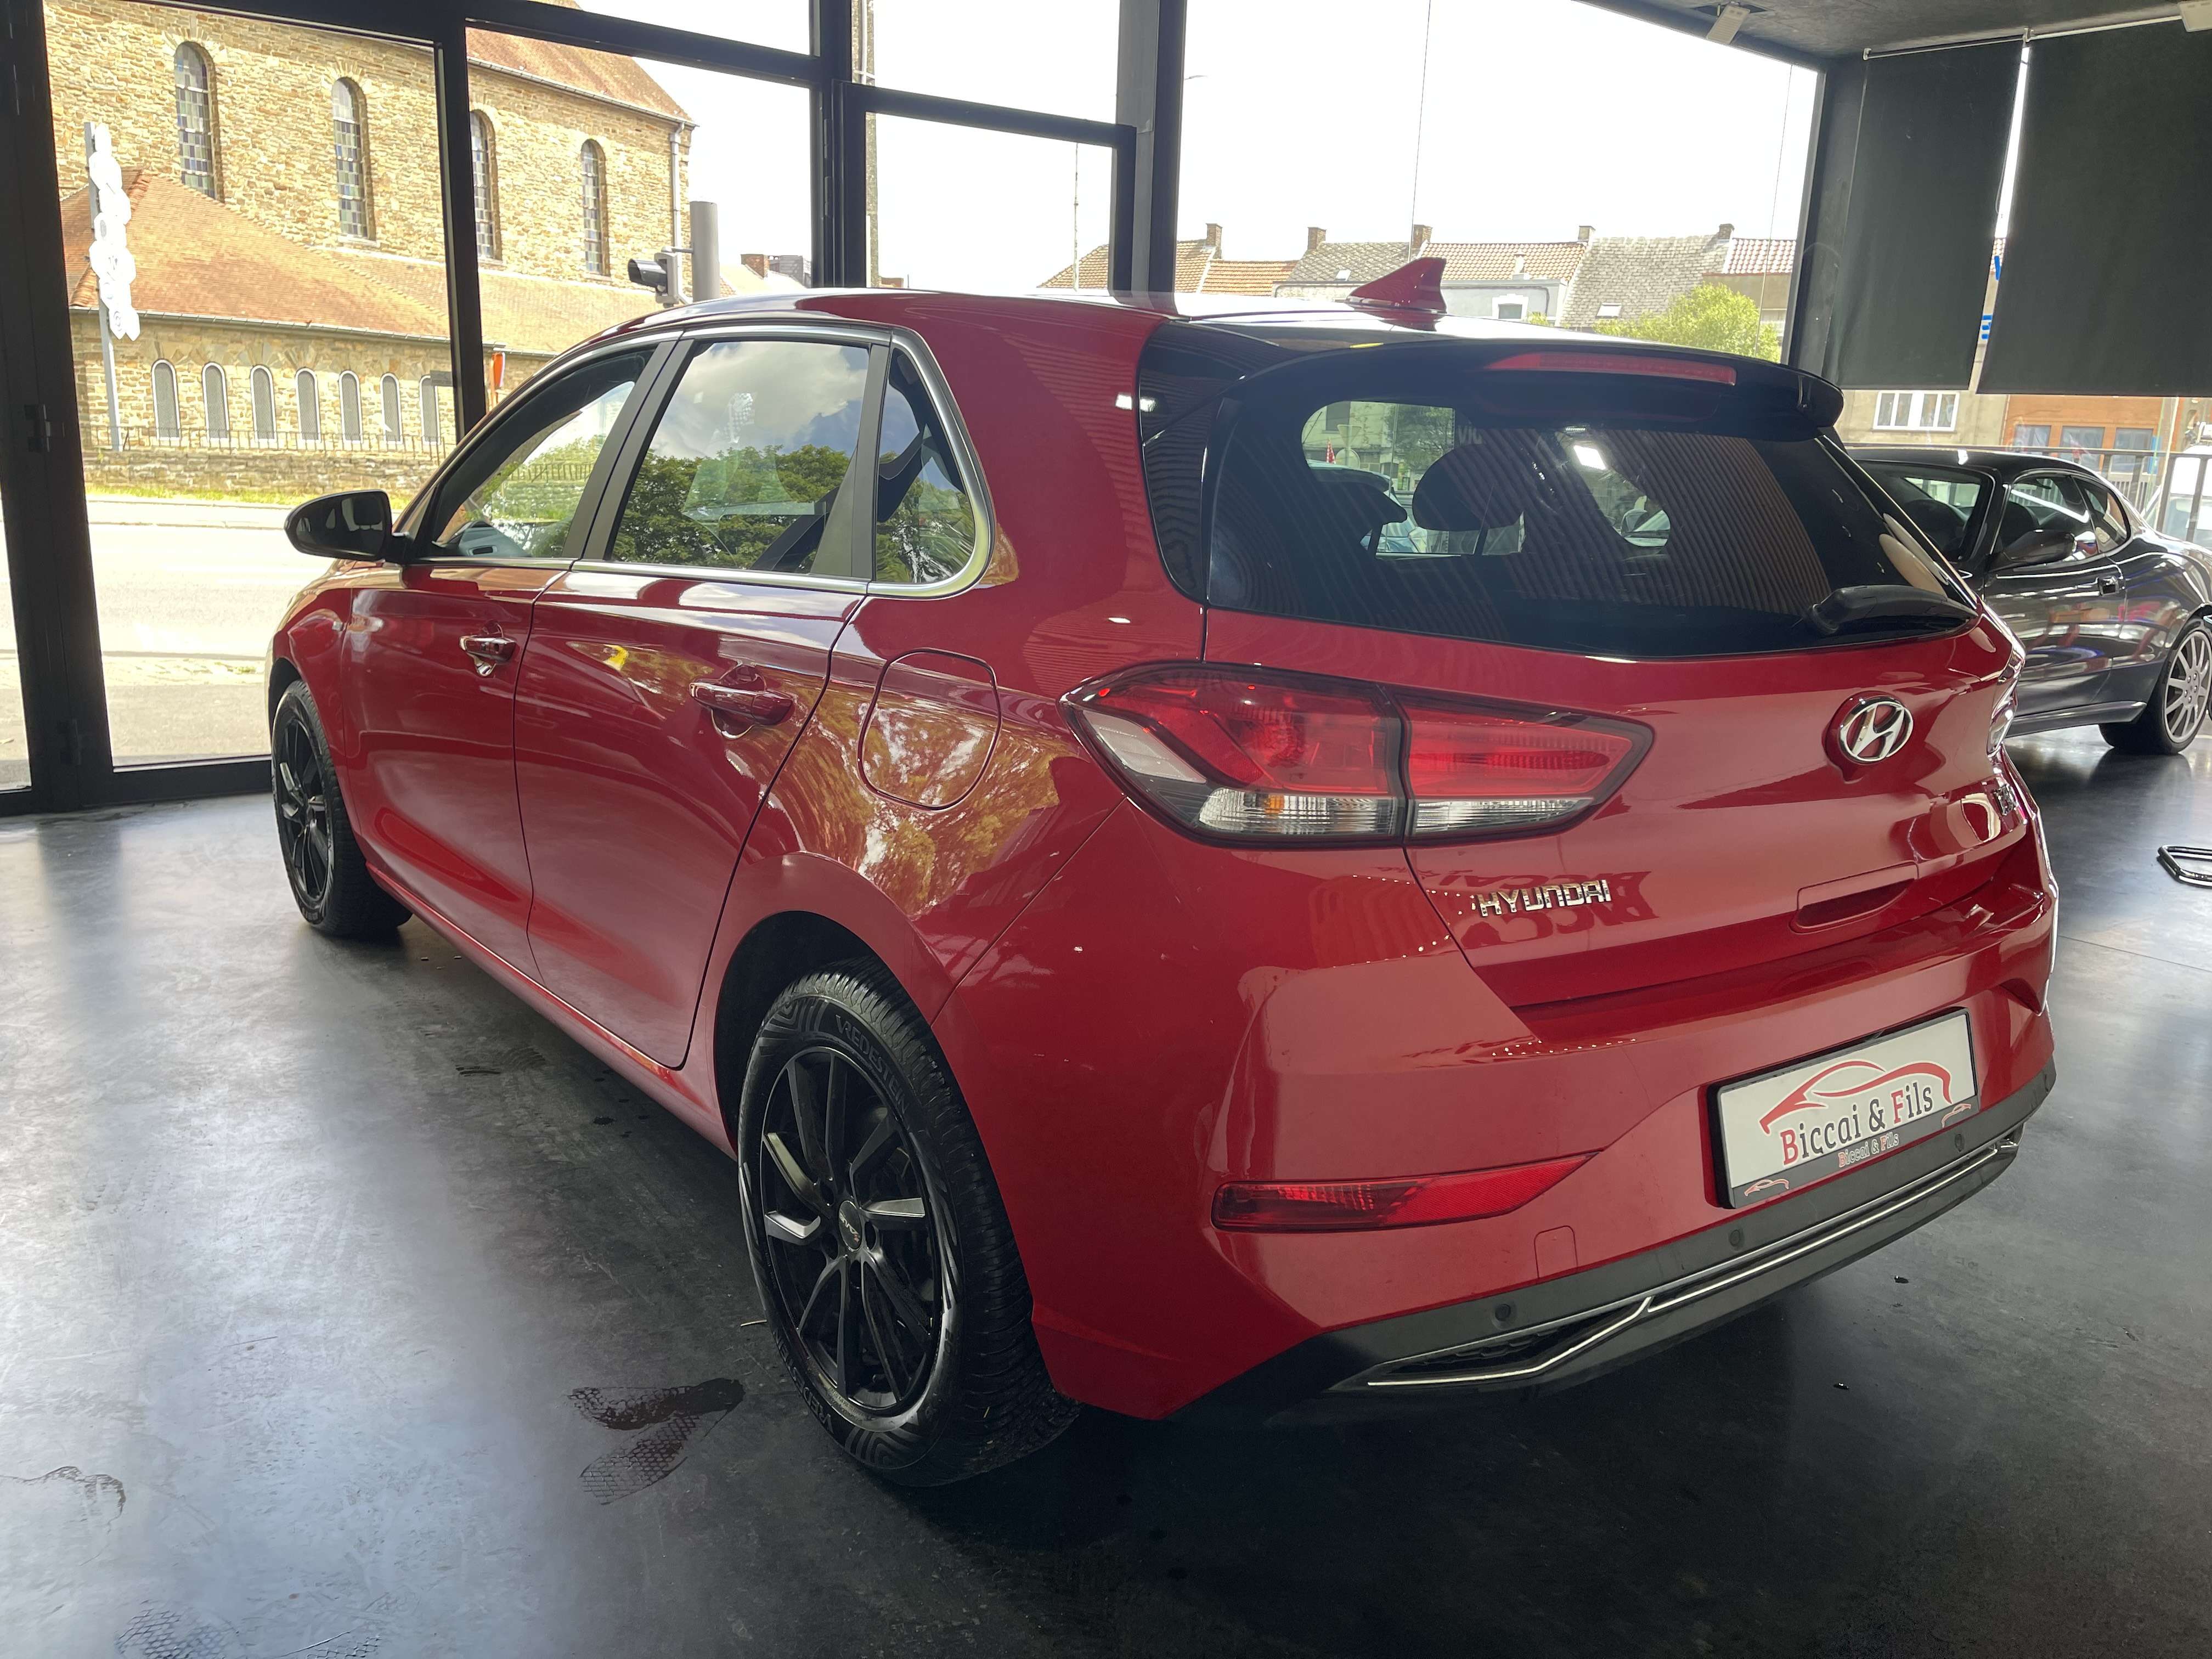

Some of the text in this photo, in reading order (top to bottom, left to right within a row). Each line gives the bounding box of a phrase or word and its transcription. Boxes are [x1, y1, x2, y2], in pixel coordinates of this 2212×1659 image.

[1476, 879, 1611, 917] HYUNDAI
[1780, 1082, 1933, 1165] Biccai & Fils
[1838, 1132, 1899, 1168] Biccai & Fils
